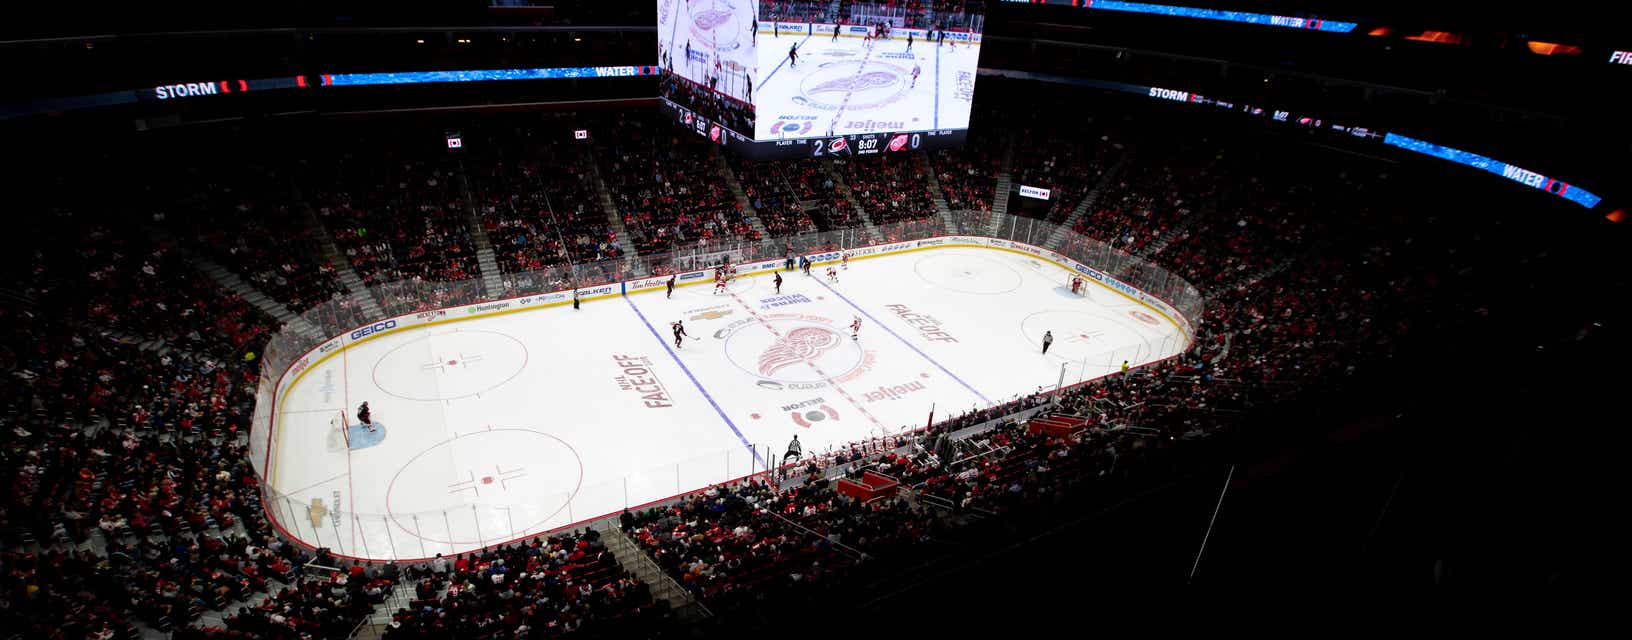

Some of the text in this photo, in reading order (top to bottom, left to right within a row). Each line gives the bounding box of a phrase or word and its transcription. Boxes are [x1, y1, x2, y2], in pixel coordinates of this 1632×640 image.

[1271, 15, 1303, 28] WATER
[1609, 50, 1632, 64] FIR
[596, 66, 634, 77] WATER
[156, 82, 217, 99] STORM
[1149, 87, 1188, 102] STORM
[844, 120, 904, 132] meijer
[721, 129, 727, 145] 0
[858, 139, 878, 150] 8:07
[912, 134, 920, 148] 0
[813, 140, 824, 156] 2
[1503, 163, 1545, 189] WATER
[1075, 263, 1103, 281] GEICO
[476, 302, 510, 313] Huntington
[351, 320, 396, 340] GEICO
[613, 354, 673, 409] FACE-OFF
[864, 381, 926, 403] meijer
[782, 397, 825, 412] BELFOR
